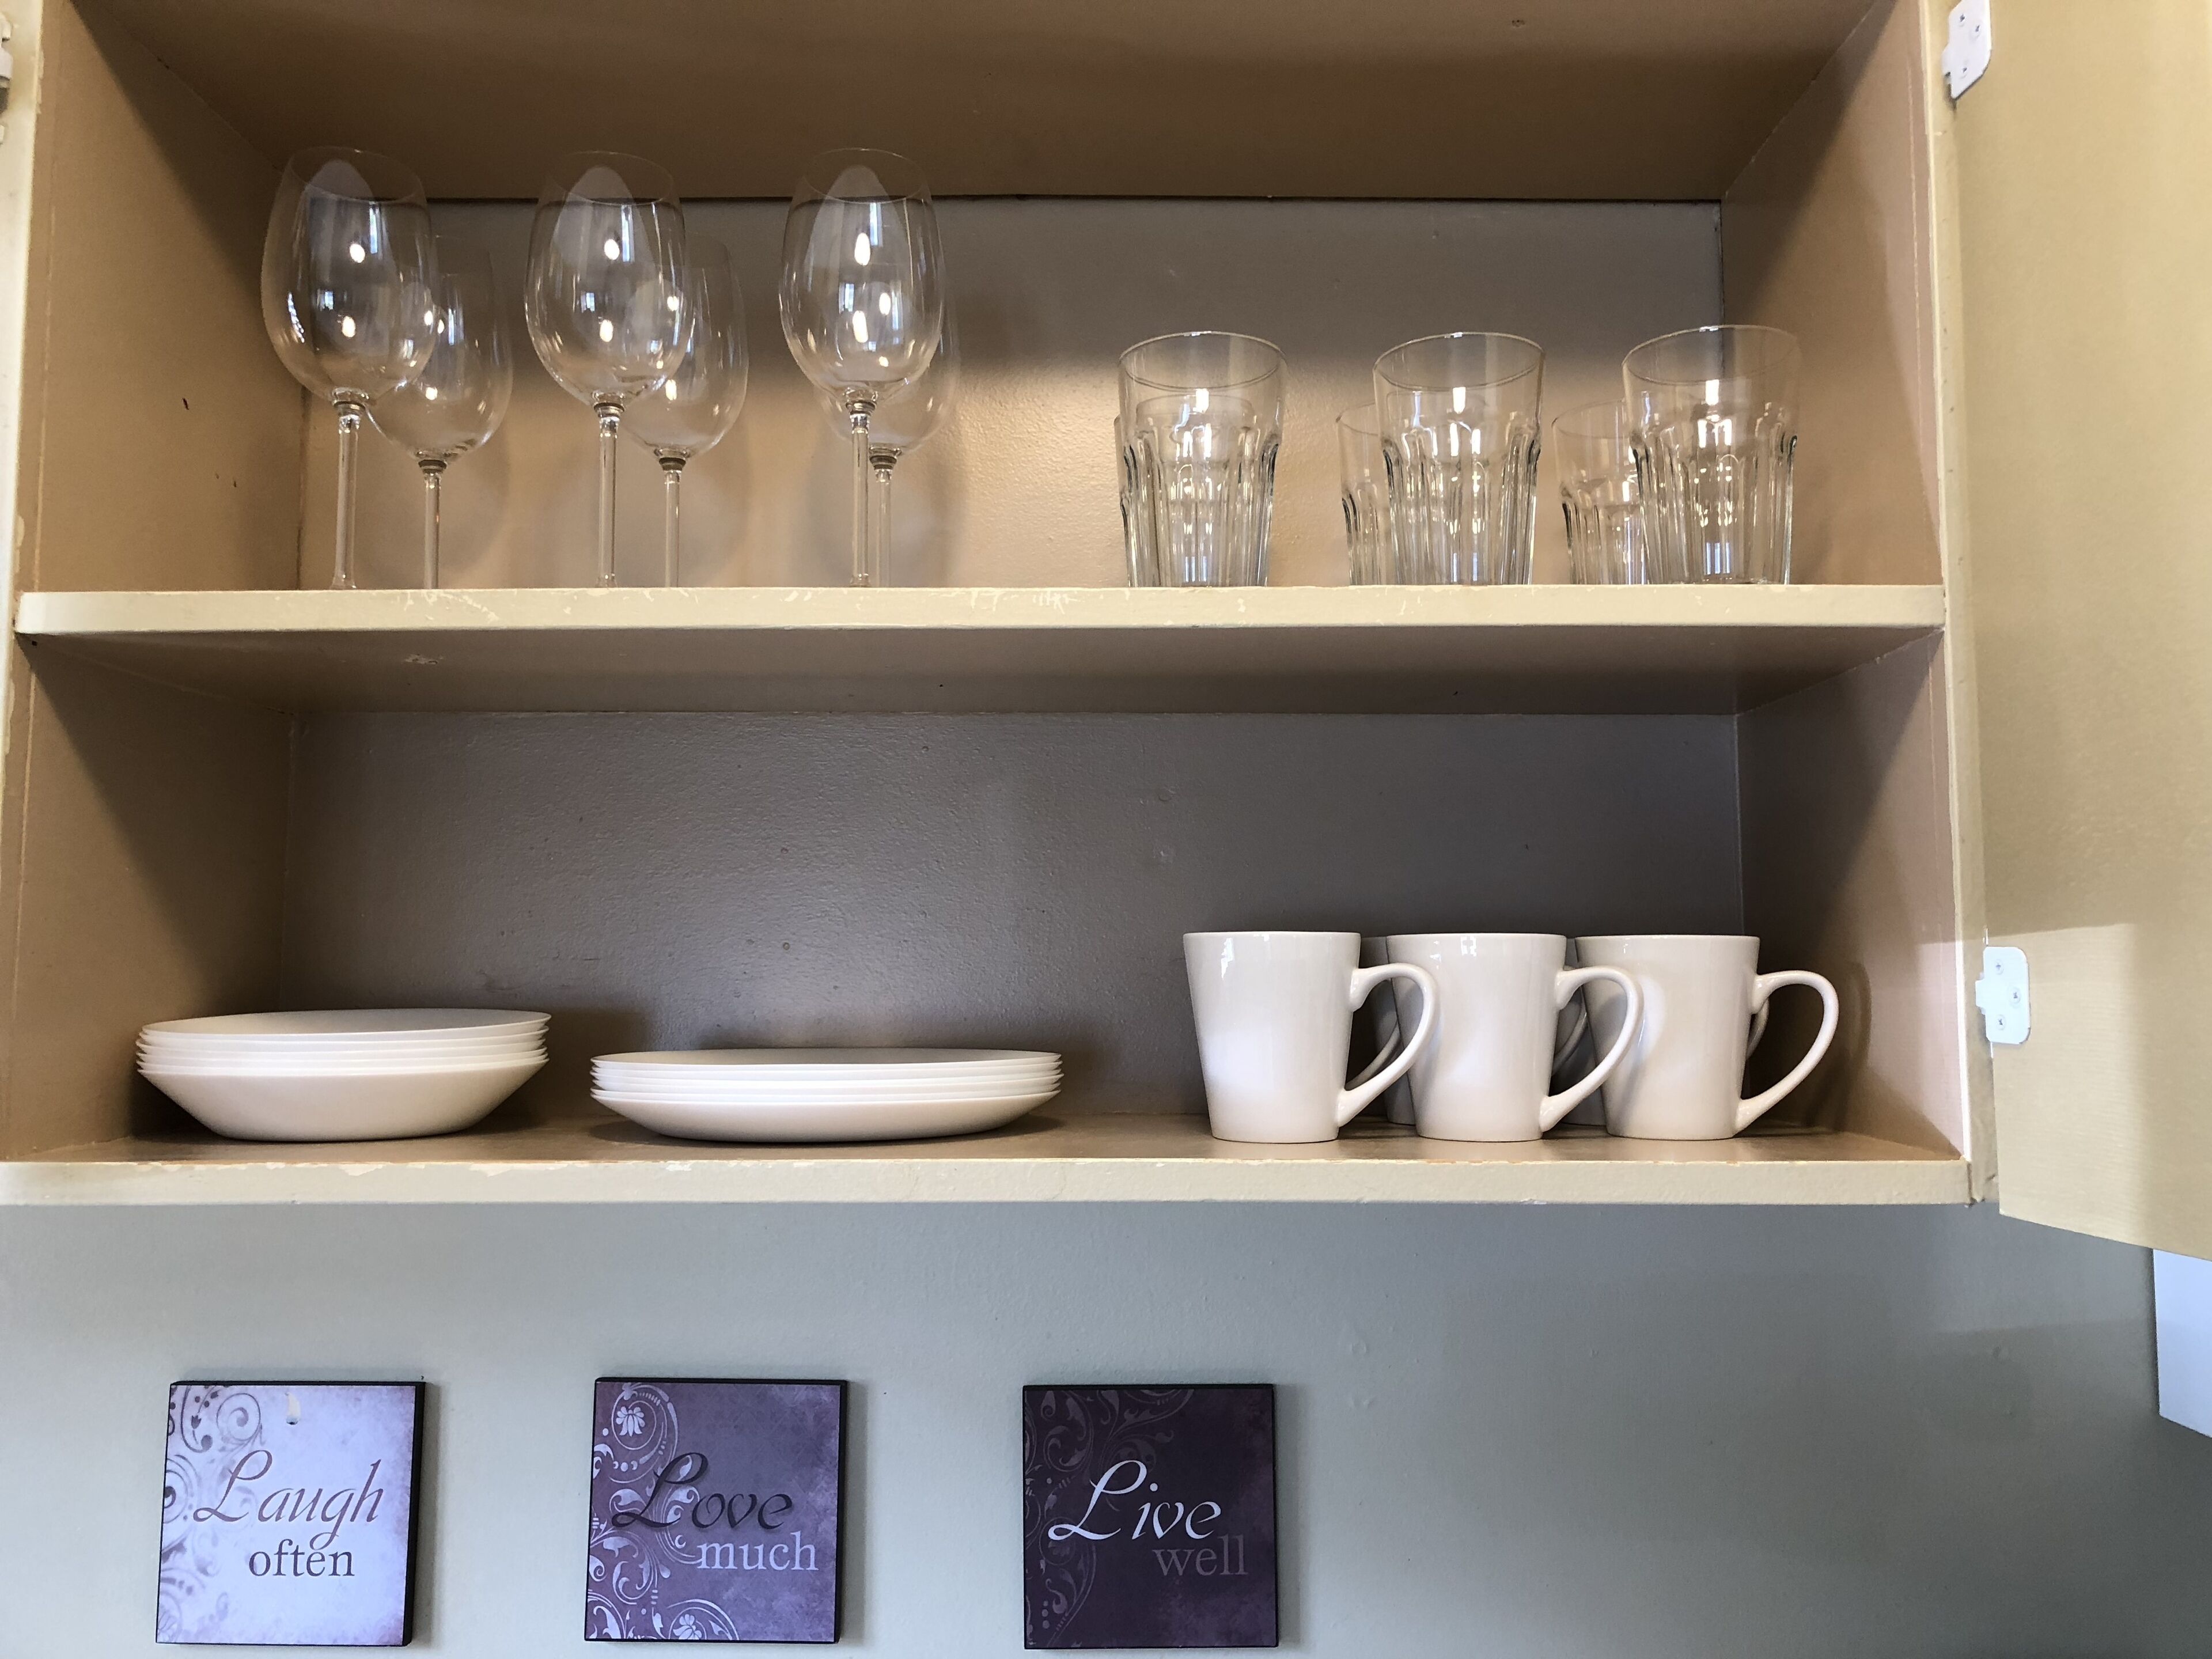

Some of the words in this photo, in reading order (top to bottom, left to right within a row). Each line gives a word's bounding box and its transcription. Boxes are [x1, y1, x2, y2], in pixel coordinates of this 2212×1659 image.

[193, 1449, 384, 1550] Laugh
[612, 1452, 793, 1529] Love
[1048, 1460, 1221, 1540] Live
[248, 1539, 355, 1577] often
[696, 1531, 819, 1571] much
[1152, 1534, 1249, 1576] well
